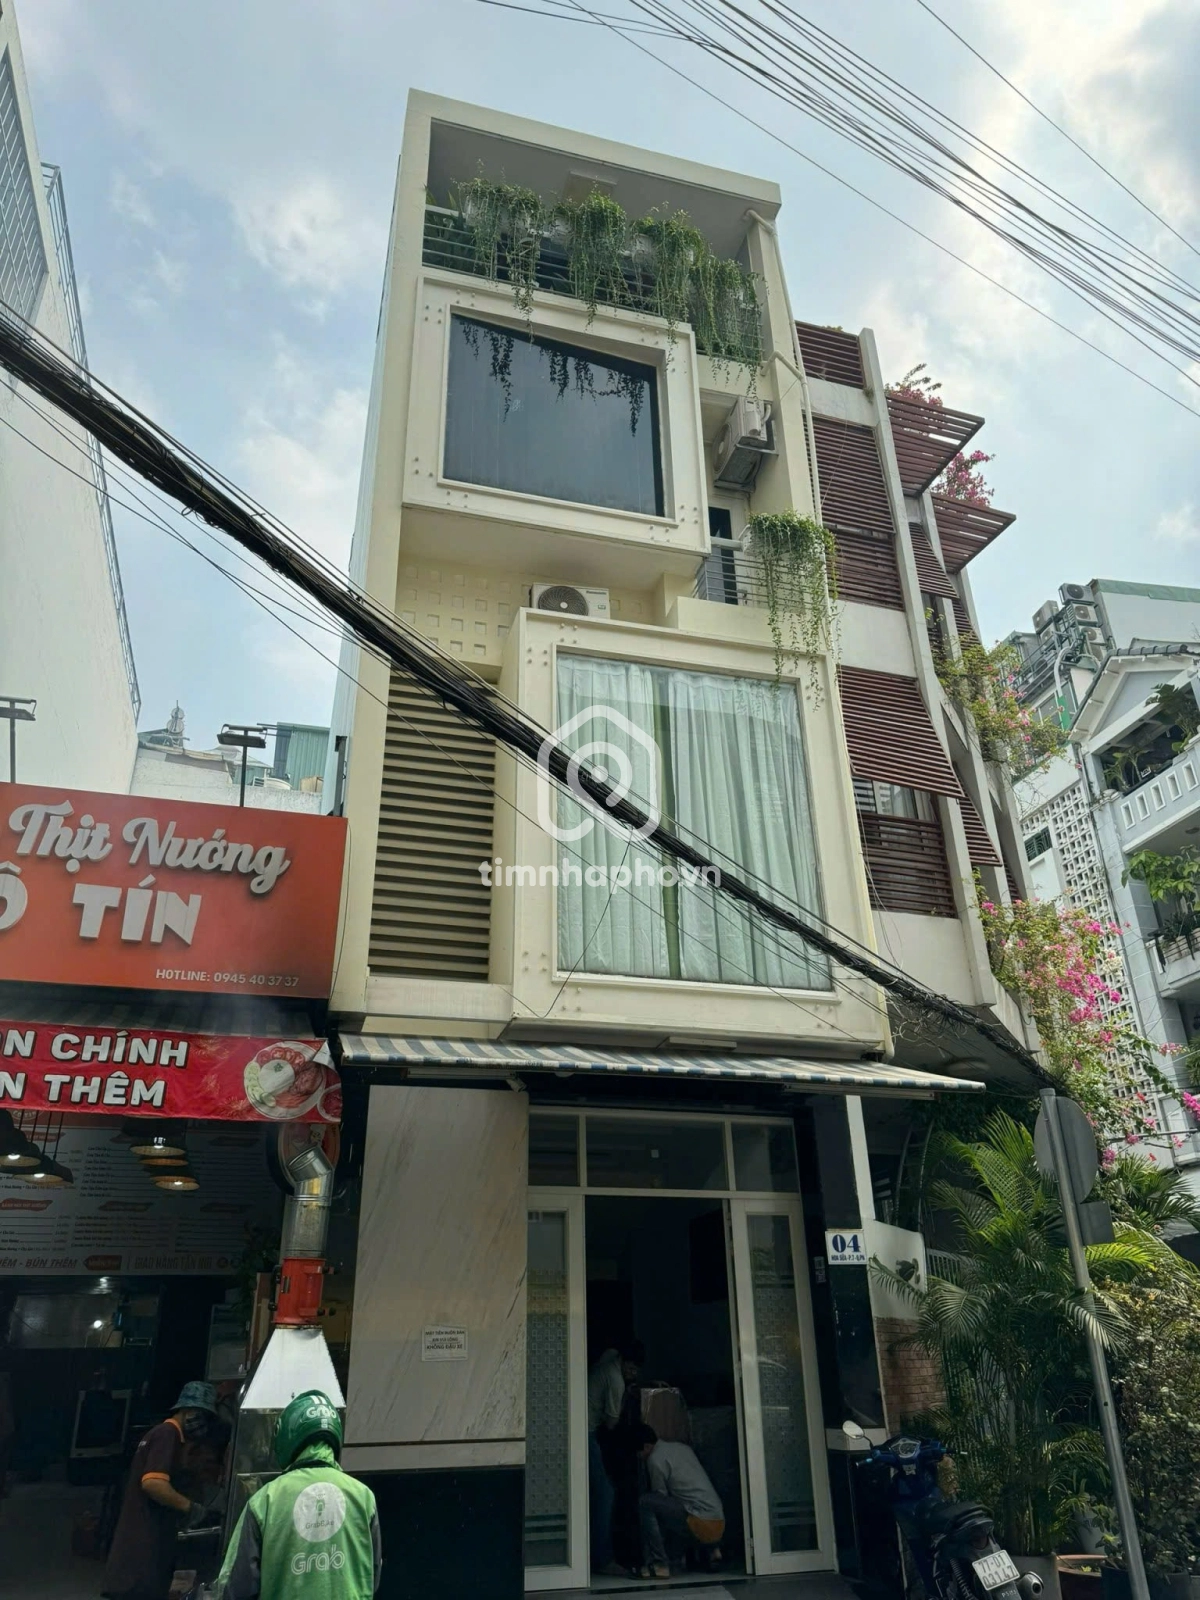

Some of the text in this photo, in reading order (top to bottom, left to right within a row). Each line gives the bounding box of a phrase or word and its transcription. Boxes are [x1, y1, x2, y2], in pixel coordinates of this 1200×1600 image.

[9, 800, 292, 895] Thịt Nướng
[73, 874, 202, 946] TÍN
[156, 968, 299, 987] HOTLINE: 0945 40 37 37
[51, 1030, 189, 1067] CHÍNH
[44, 1071, 166, 1107] THÊM
[832, 1234, 861, 1253] 04
[306, 1404, 337, 1418] Grab
[291, 1544, 345, 1575] Grab
